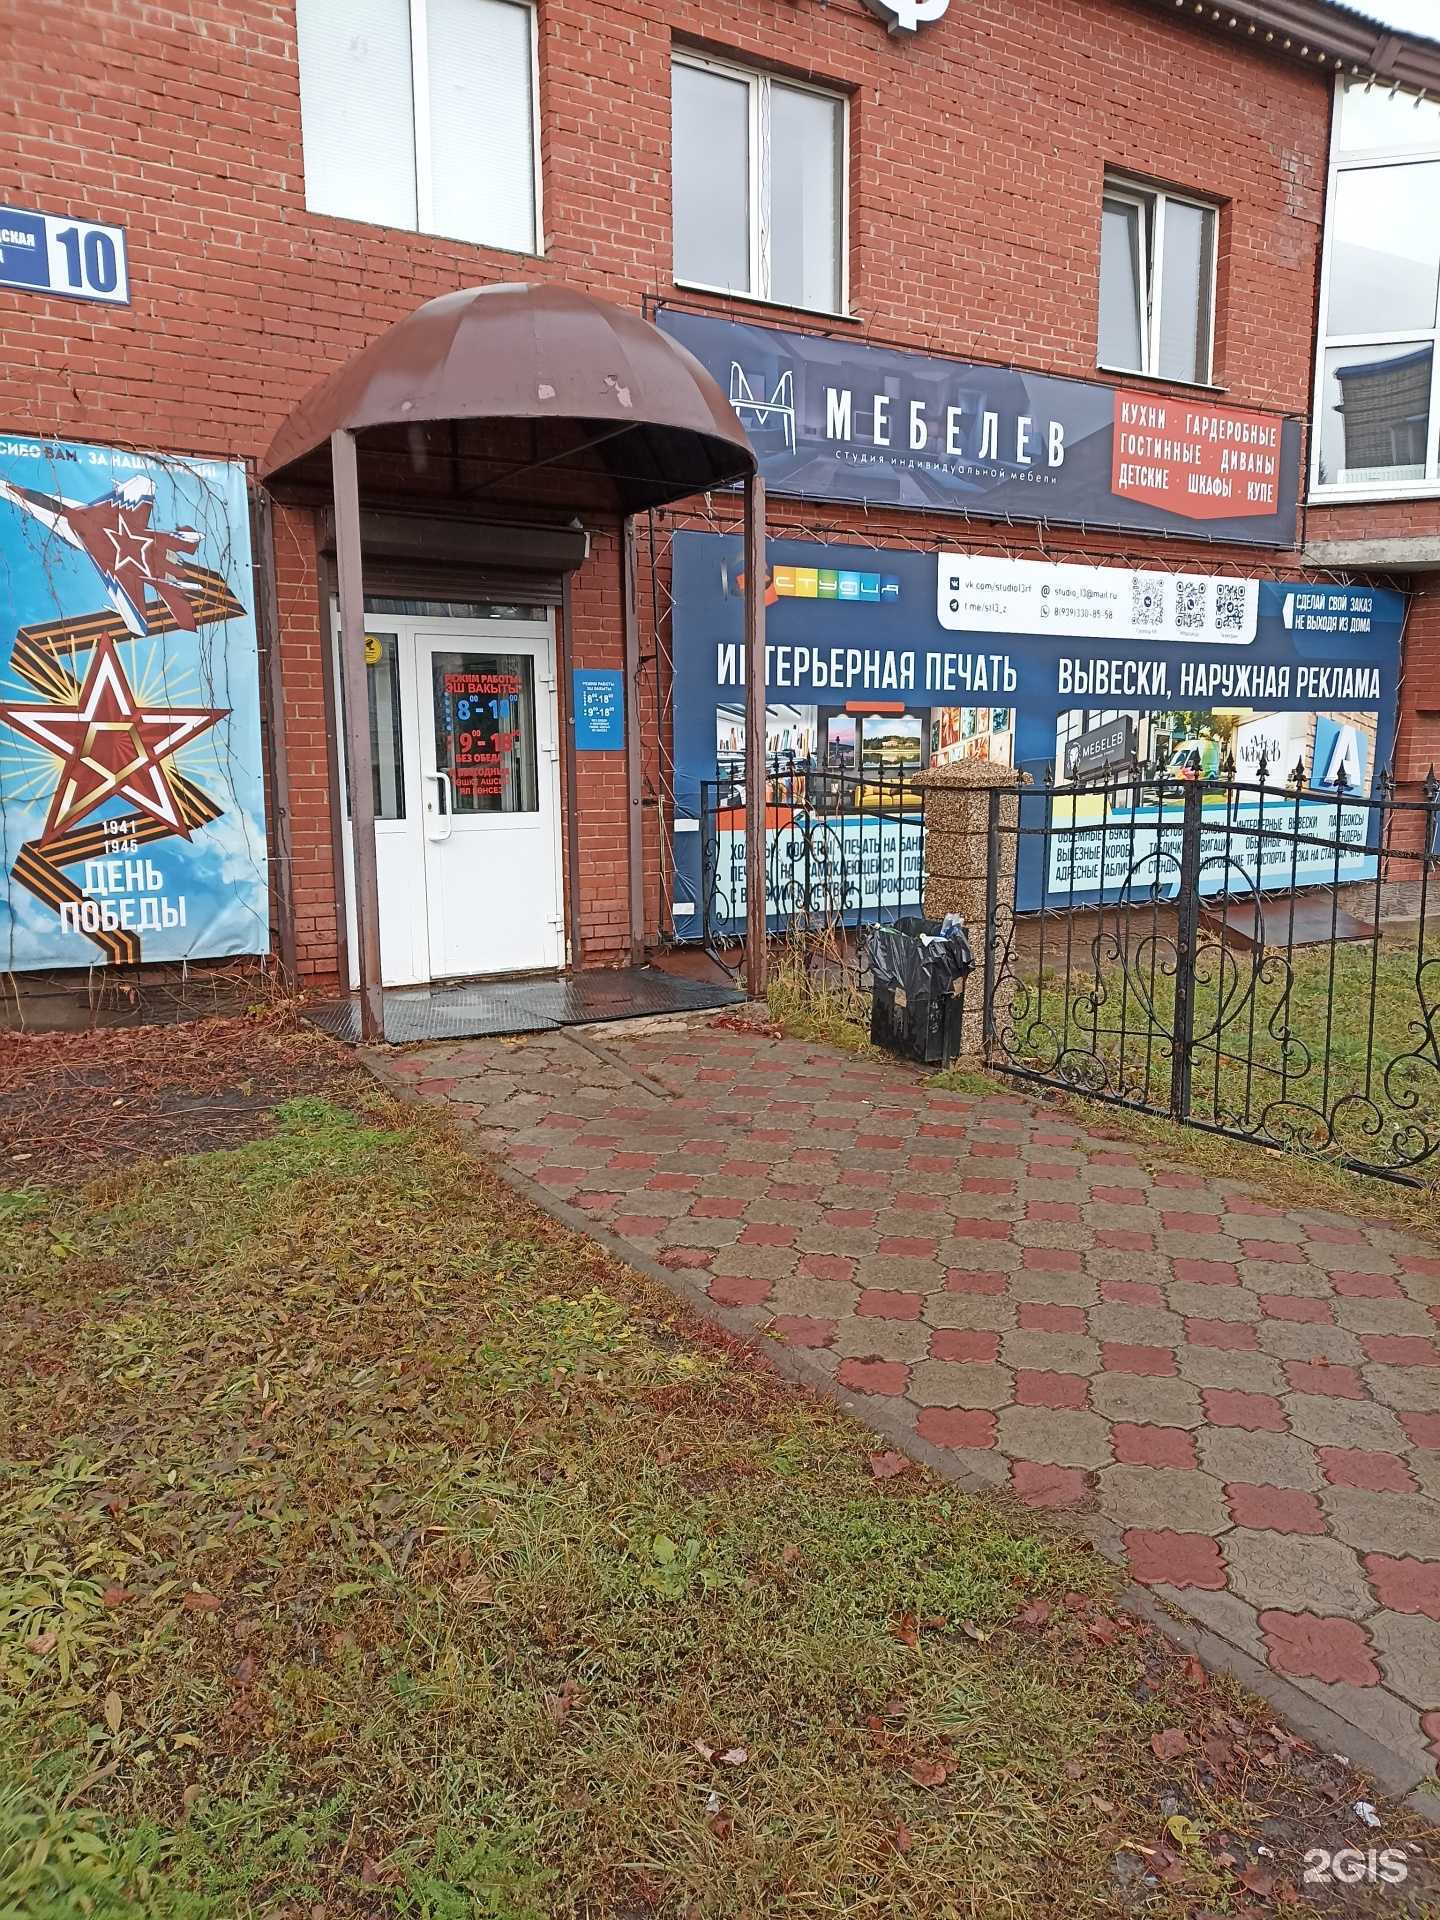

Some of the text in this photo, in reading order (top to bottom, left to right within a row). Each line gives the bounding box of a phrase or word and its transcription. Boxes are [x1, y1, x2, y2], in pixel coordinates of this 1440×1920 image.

[0, 228, 35, 247] СКАЯ
[56, 227, 117, 292] 10
[826, 387, 1065, 467] МЕБЕЛЕВ
[1121, 402, 1276, 447] КУХНИ ГАРДЕРОБНЫЕ
[88, 452, 108, 465] ЗА
[835, 450, 1057, 484] студия индивидуальной мебели
[1120, 433, 1275, 475] ГОСТИННЫЕ ДИВАНЫ
[1119, 463, 1273, 503] ДЕТСКИЕ ШКАФЫ КУПЕ
[1296, 593, 1373, 612] СДЕЛАЙ СВОЙ ЗАКАЗ
[1295, 615, 1371, 632] НЕ ВЫХОДЯ ИЗ ДОМА
[925, 652, 1017, 692] ПЕЧАТЬ
[1058, 658, 1380, 699] ВЫВЕСКИ, НАРУЖНАЯ РЕКЛАМА
[102, 820, 136, 835] 1941
[884, 838, 896, 852] НА
[104, 840, 138, 854] 1945
[1311, 849, 1319, 860] НА
[81, 859, 164, 896] ДЕНЬ
[59, 896, 187, 934] ПОБЕДЫ
